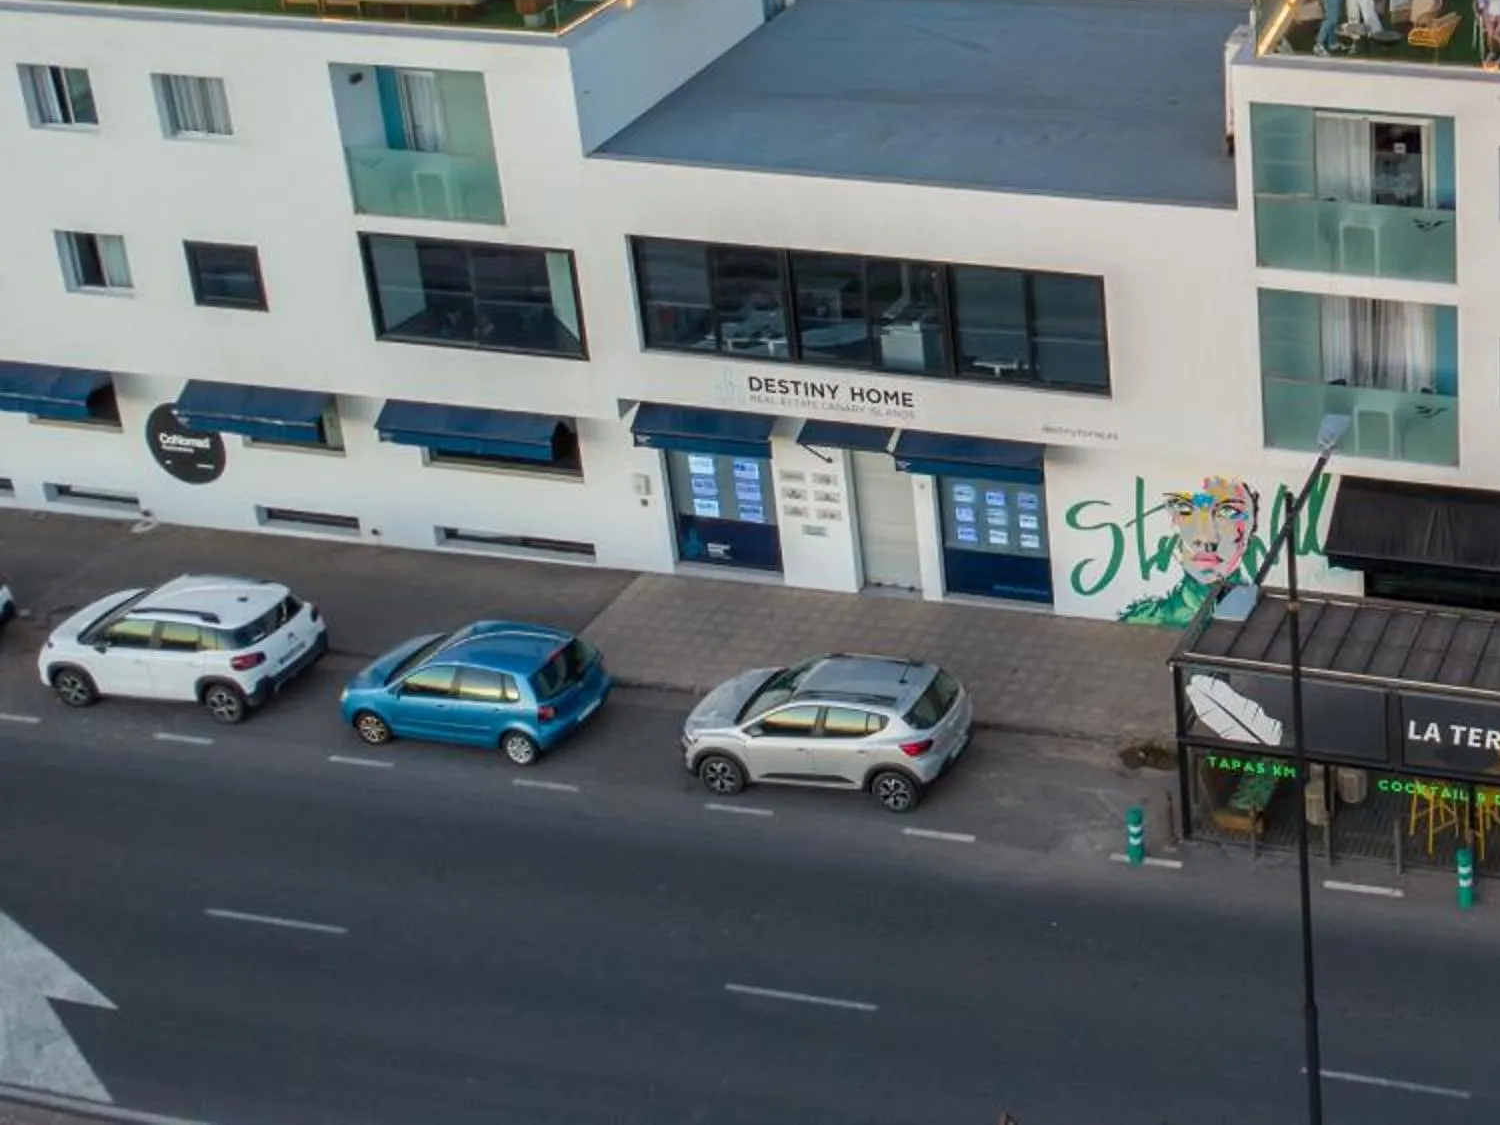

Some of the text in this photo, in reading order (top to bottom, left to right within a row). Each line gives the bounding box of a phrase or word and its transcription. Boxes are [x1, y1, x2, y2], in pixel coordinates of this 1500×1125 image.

[748, 376, 914, 408] DESTINY HOME
[1407, 720, 1441, 743] LA
[1207, 756, 1296, 778] TAPAS KM
[1377, 779, 1469, 801] COCKTAIL
